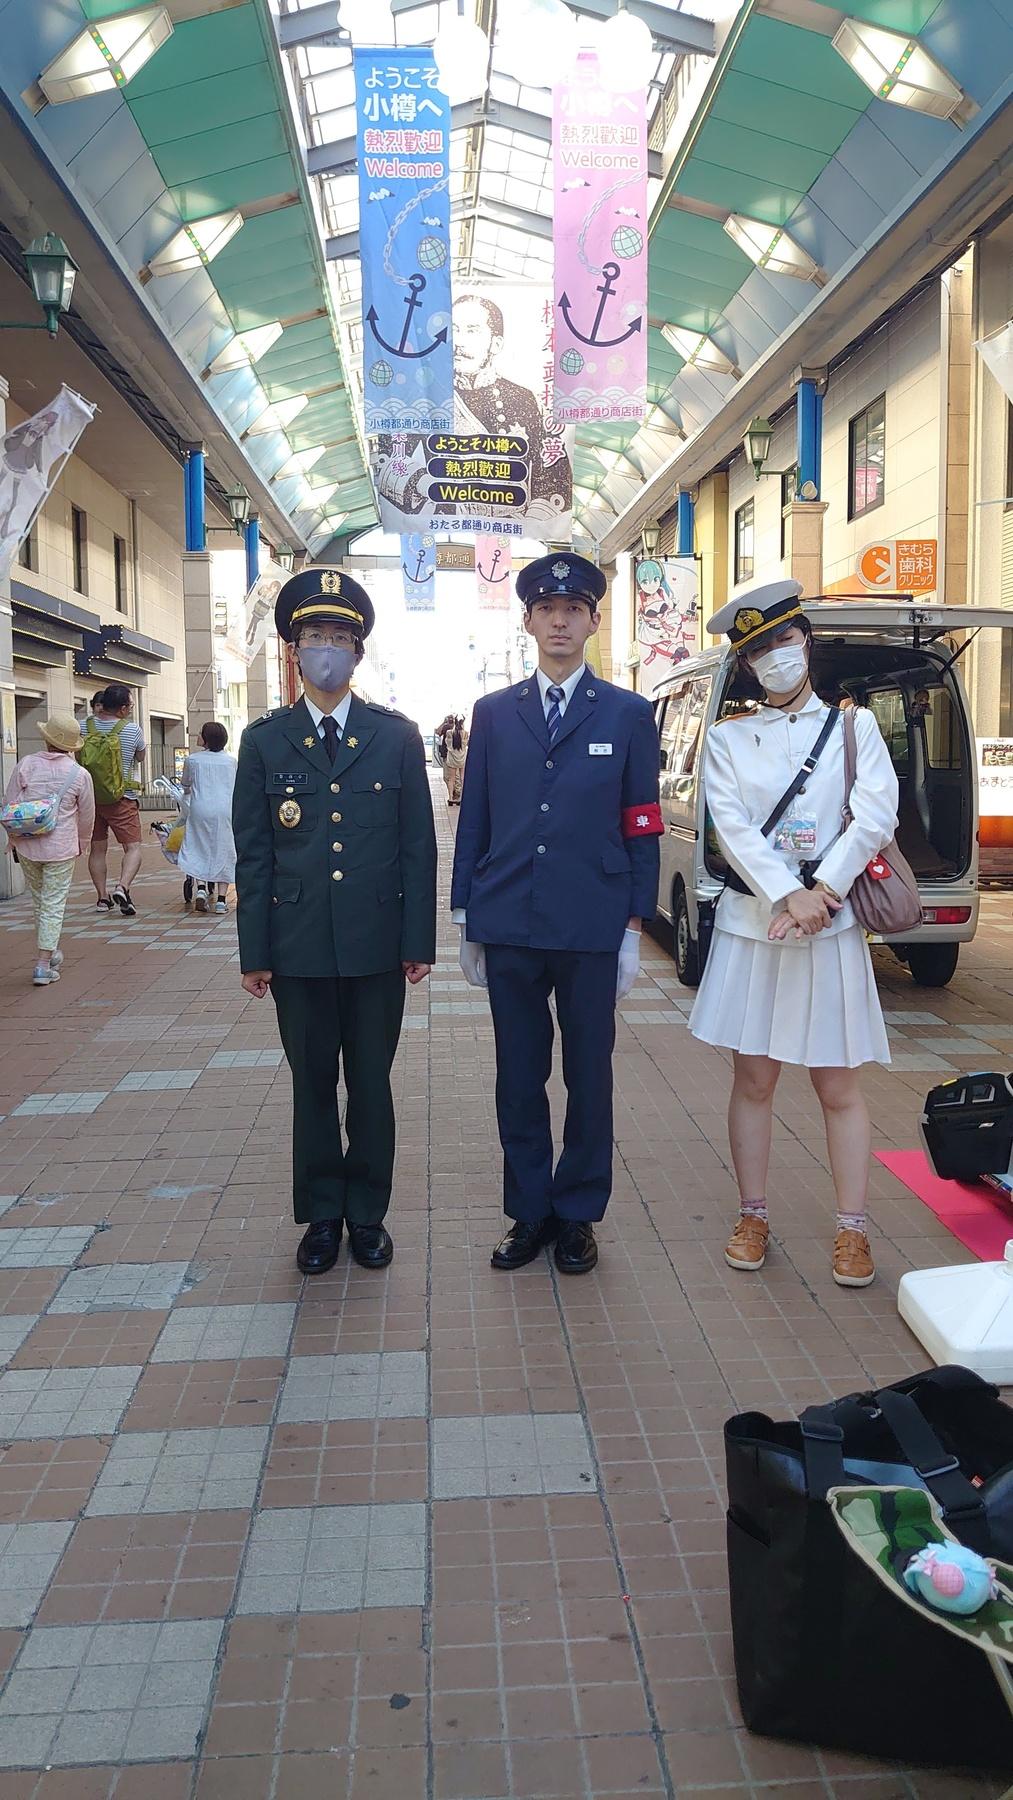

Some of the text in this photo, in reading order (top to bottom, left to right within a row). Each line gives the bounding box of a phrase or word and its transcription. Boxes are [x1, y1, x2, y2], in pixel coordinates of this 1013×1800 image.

[364, 67, 440, 89] ようこそ
[363, 93, 443, 122] 小樽へ
[366, 158, 443, 177] Welcome
[561, 151, 638, 169] Welcome
[558, 405, 644, 420] 小樽都通り商店街
[369, 418, 450, 430] 小樽都通り商店街
[435, 437, 522, 453] ようこそ小樽へ
[439, 485, 514, 504] Welcome
[428, 519, 523, 535] おたる都通り商店街
[898, 543, 934, 556] きむら
[898, 556, 934, 573] 歯科
[899, 574, 934, 586] クリニック
